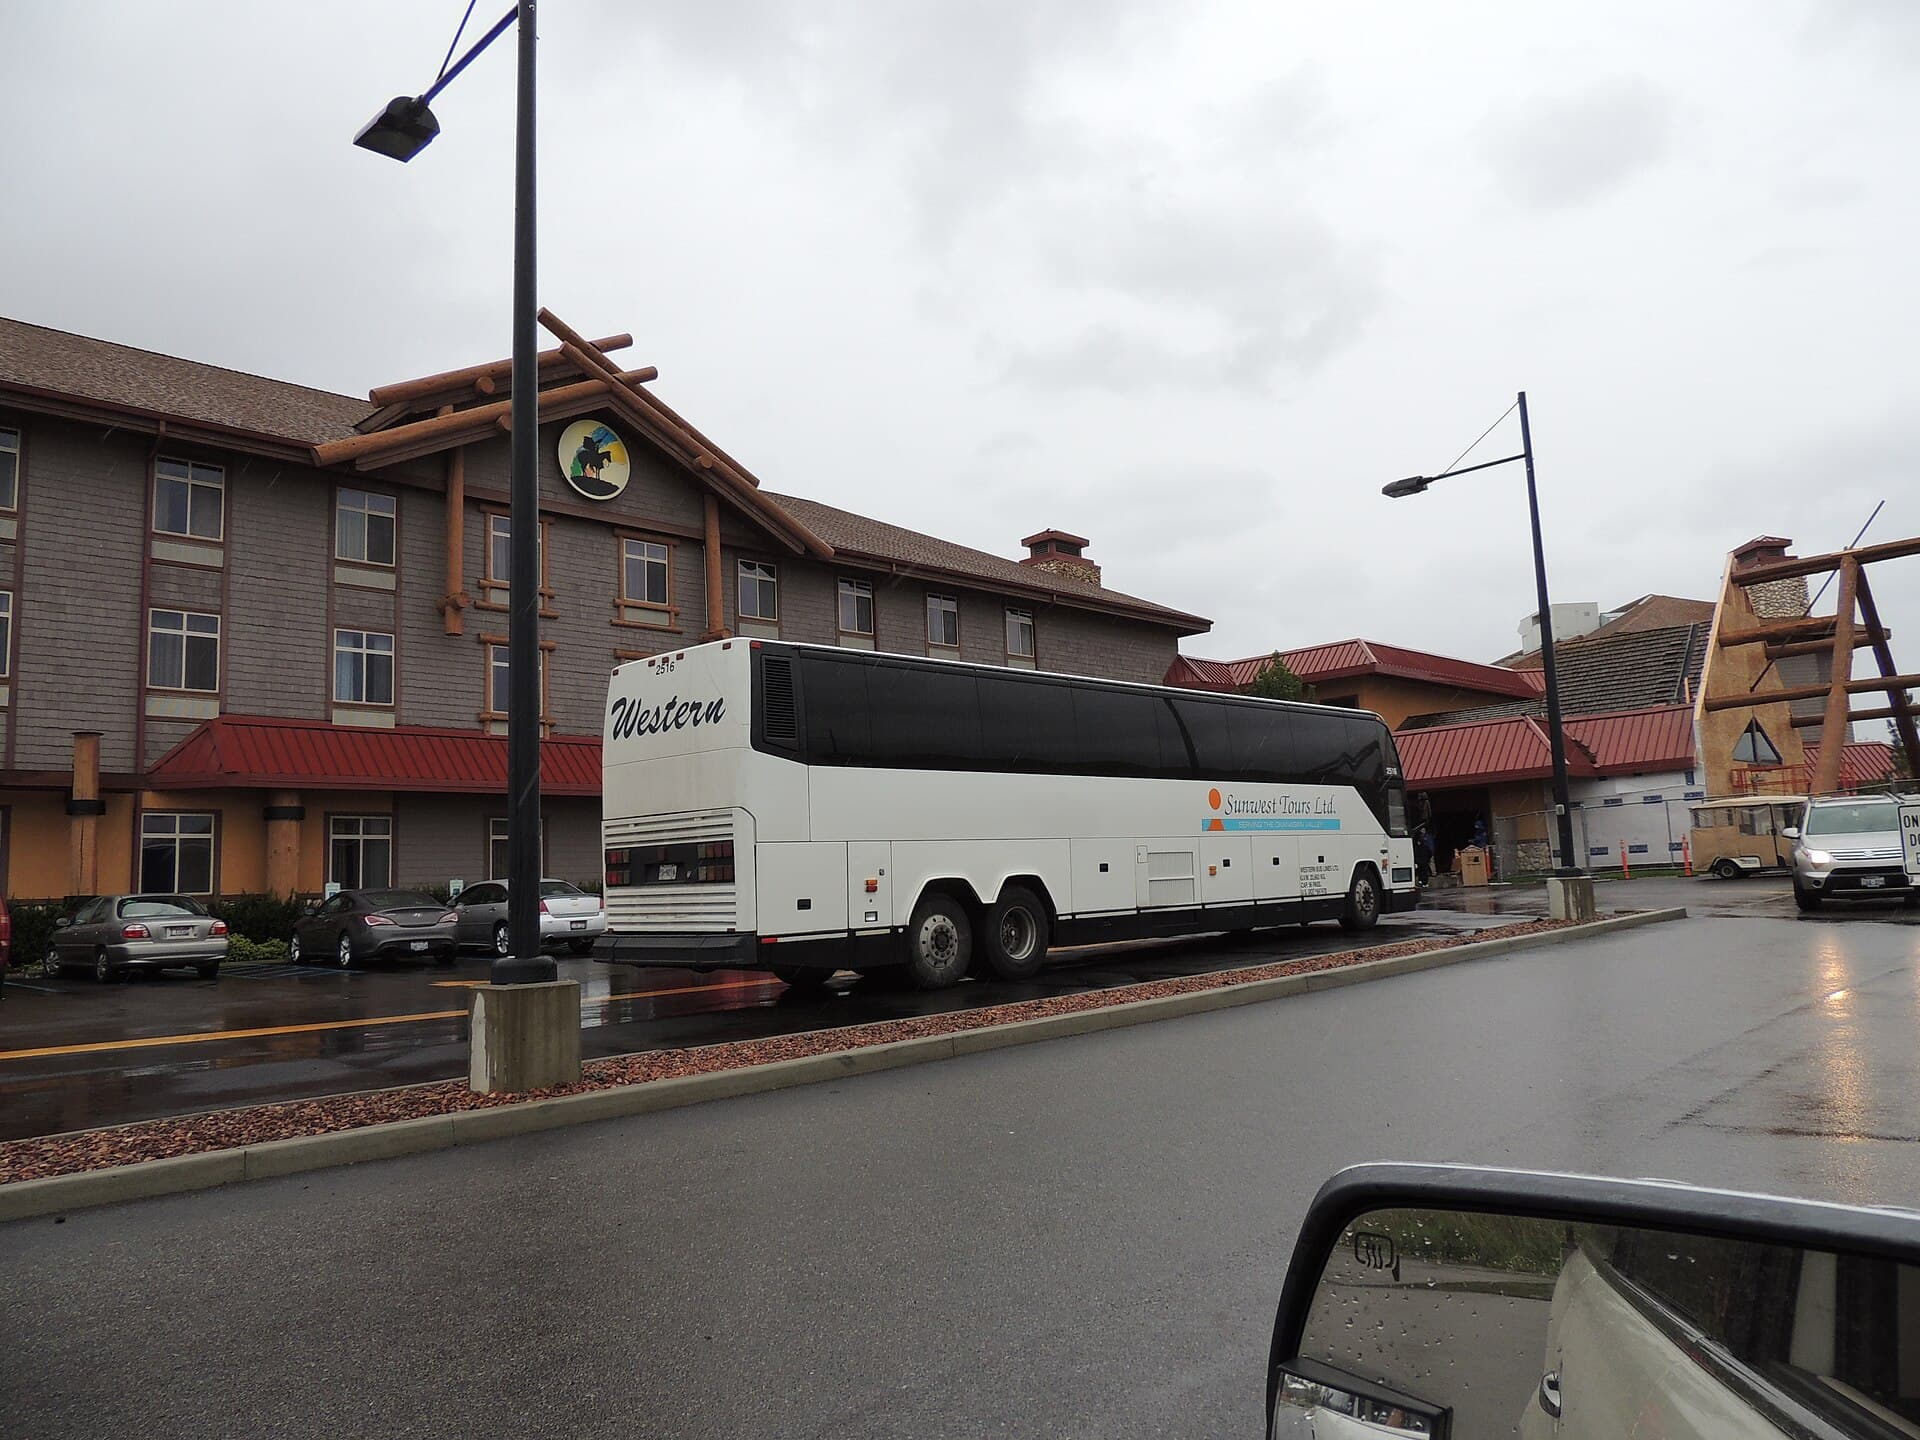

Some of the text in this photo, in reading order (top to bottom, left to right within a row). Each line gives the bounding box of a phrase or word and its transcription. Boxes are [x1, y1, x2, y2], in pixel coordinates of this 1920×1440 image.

[655, 661, 675, 676] 2516
[611, 695, 726, 741] Western
[1224, 793, 1337, 816] Sunwest Tours Ltd.
[1903, 814, 1920, 828] ON
